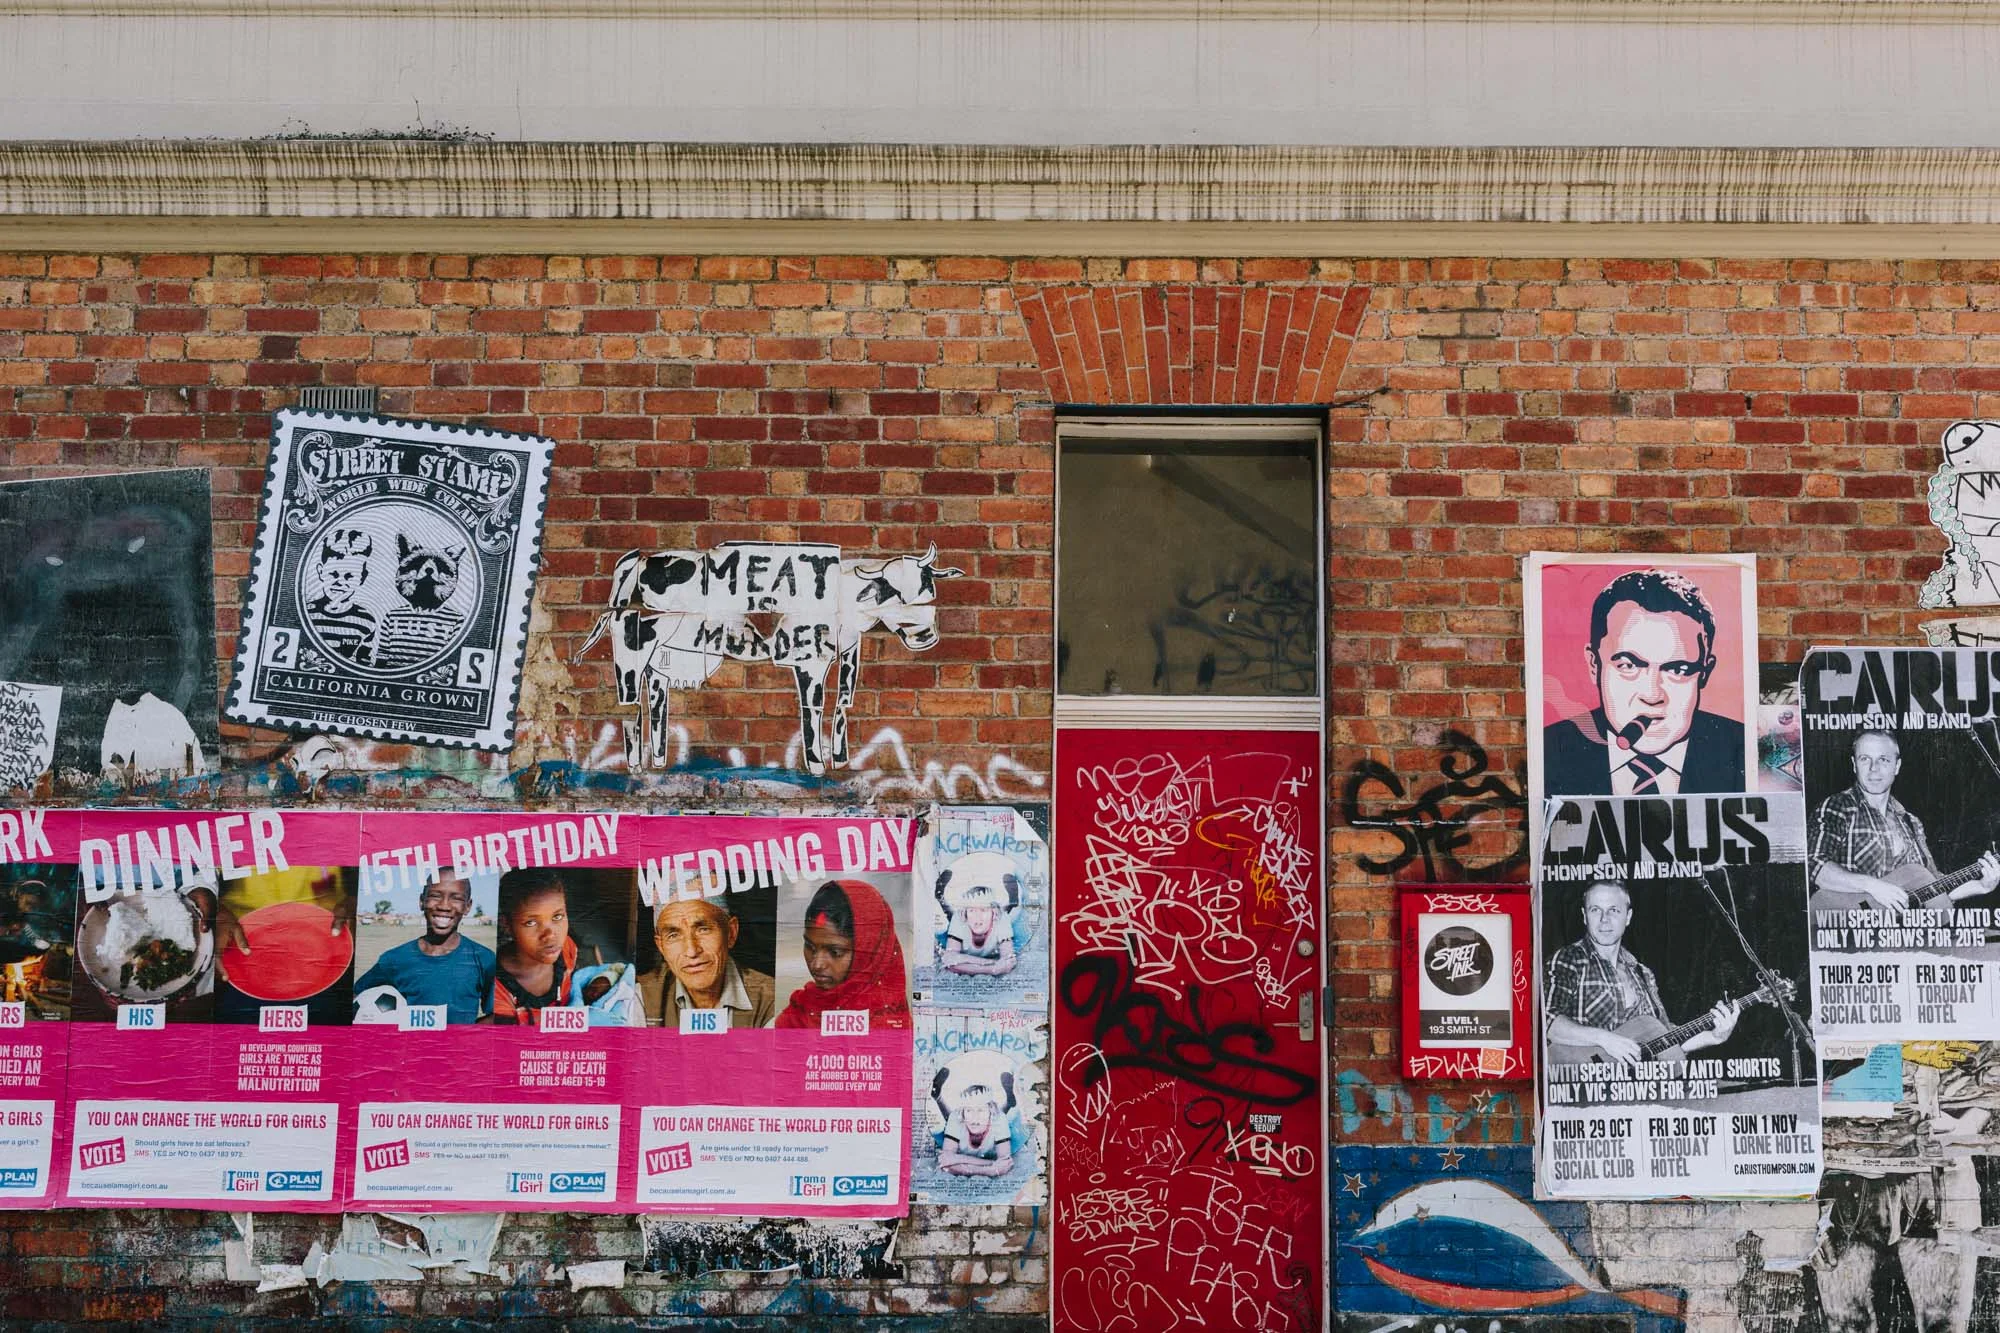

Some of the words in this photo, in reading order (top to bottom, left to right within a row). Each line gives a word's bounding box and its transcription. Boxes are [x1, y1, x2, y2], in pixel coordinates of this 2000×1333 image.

[309, 448, 405, 483] STREET
[418, 454, 515, 497] STAMP
[323, 479, 379, 514] WORLD
[388, 478, 430, 497] WIDE
[434, 488, 479, 528] COLAB
[701, 550, 839, 599] MEAT
[271, 631, 290, 663] 2
[269, 674, 391, 699] CALIFORNIA
[401, 688, 475, 709] GROWN
[1800, 651, 2000, 718] CARU
[312, 712, 336, 724] THE
[338, 714, 388, 729] CHOSEN
[391, 720, 417, 731] FEW
[1806, 712, 1898, 730] THOMPSON
[1903, 711, 1924, 730] AND
[1927, 712, 1972, 730] BAND
[1542, 797, 1770, 866] CARUS
[80, 811, 289, 904] DINNER
[359, 843, 441, 896] 15TH
[450, 814, 619, 881] BIRTHDAY
[637, 833, 827, 907] WEDDING
[837, 819, 913, 875] DAY
[1540, 863, 1628, 882] THOMPSON
[1633, 861, 1655, 880] AND
[1658, 861, 1702, 879] BAND
[1816, 909, 1847, 928] WITH
[1848, 908, 1899, 928] SPECIAL
[1903, 908, 1944, 928] GUEST
[1949, 908, 1991, 927] YANTO
[1816, 929, 1849, 949] ONLY
[1853, 929, 1875, 948] VIC
[1878, 929, 1924, 948] SHOWS
[1928, 928, 1952, 947] FOR
[1955, 928, 1986, 948] 2015
[1430, 942, 1480, 971] STREET
[1446, 961, 1481, 982] INK
[1819, 965, 1853, 984] THUR
[1857, 965, 1873, 984] 29
[1877, 964, 1900, 984] OCT
[1916, 964, 1936, 983] FRI
[1940, 964, 1956, 983] 30
[1960, 964, 1984, 983] OCT
[1820, 984, 1893, 1005] NORTHCOTE
[1917, 984, 1976, 1006] TORQUAY
[128, 1008, 154, 1026] HIS
[264, 1010, 304, 1028] HERS
[410, 1010, 436, 1027] HIS
[545, 1010, 585, 1029] HERS
[691, 1013, 717, 1031] HIS
[825, 1014, 865, 1032] HERS
[1441, 1016, 1472, 1025] LEVEL
[1473, 1016, 1479, 1025] 1
[1821, 1004, 1866, 1025] SOCIAL
[1870, 1004, 1902, 1024] CLUB
[1918, 1004, 1957, 1023] HOTEL
[1429, 1026, 1445, 1034] 193
[1446, 1026, 1477, 1034] SMITH
[1479, 1026, 1492, 1034] ST
[13, 1045, 43, 1058] GIRLS
[248, 1044, 286, 1053] DEVELOPING
[520, 1050, 560, 1060] CHILDBIRTH
[577, 1051, 606, 1060] LEADING
[25, 1059, 42, 1074] AN
[240, 1053, 263, 1064] GIRLS
[265, 1054, 281, 1064] ARE
[283, 1054, 309, 1064] TWICE
[520, 1061, 553, 1075] CAUSE
[556, 1061, 570, 1075] OF
[573, 1061, 606, 1075] DEATH
[806, 1054, 844, 1071] 41,000
[848, 1054, 882, 1070] GIRLS
[239, 1065, 266, 1076] LIKELY
[297, 1066, 321, 1077] FROM
[861, 1071, 882, 1081] THEIR
[1550, 1064, 1579, 1083] WITH
[1580, 1061, 1632, 1082] SPECIAL
[1635, 1060, 1676, 1081] GUEST
[1679, 1059, 1723, 1080] YANTO
[1726, 1057, 1781, 1079] SHORTIS
[238, 1077, 320, 1092] MALNUTRITION
[520, 1076, 535, 1086] FOR
[537, 1076, 560, 1086] GIRLS
[561, 1076, 582, 1087] AGED
[585, 1076, 606, 1087] 15-19
[805, 1081, 844, 1091] CHILDHOOD
[1550, 1083, 1580, 1104] ONLY
[1585, 1082, 1607, 1102] VIC
[1610, 1081, 1657, 1101] SHOWS
[1660, 1080, 1684, 1100] FOR
[1688, 1079, 1718, 1099] 2015
[8, 1111, 43, 1126] GIRLS
[88, 1111, 110, 1126] YOU
[114, 1111, 138, 1126] CAN
[142, 1112, 190, 1127] CHANGE
[194, 1113, 216, 1128] THE
[220, 1113, 261, 1128] WORLD
[266, 1114, 288, 1128] FOR
[292, 1114, 327, 1129] GIRLS
[371, 1113, 394, 1128] YOU
[397, 1114, 421, 1128] CAN
[425, 1114, 472, 1129] CHANGE
[477, 1114, 499, 1129] THE
[503, 1115, 545, 1130] WORLD
[548, 1115, 571, 1130] FOR
[575, 1116, 609, 1130] GIRLS
[653, 1116, 675, 1131] YOU
[680, 1117, 703, 1131] CAN
[707, 1117, 755, 1132] CHANGE
[759, 1118, 781, 1132] THE
[785, 1118, 826, 1133] WORLD
[831, 1119, 852, 1133] FOR
[857, 1119, 890, 1133] GIRLS
[1648, 1118, 1668, 1137] FRI
[1673, 1117, 1689, 1136] 30
[1693, 1116, 1717, 1136] OCT
[1732, 1115, 1758, 1135] SUN
[1761, 1115, 1768, 1134] 1
[1772, 1114, 1798, 1134] NOV
[1552, 1120, 1585, 1140] THUR
[1589, 1119, 1606, 1139] 29
[1610, 1118, 1633, 1138] OCT
[135, 1139, 159, 1147] Should
[160, 1140, 176, 1148] girls
[714, 1145, 729, 1153] girls
[1553, 1139, 1625, 1160] NORTHCOTE
[1650, 1137, 1709, 1160] TORQUAY
[1733, 1135, 1772, 1155] LORNE
[1776, 1134, 1815, 1154] HOTEL
[82, 1143, 122, 1167] VOTE
[366, 1145, 406, 1169] VOTE
[648, 1149, 688, 1173] VOTE
[5, 1172, 35, 1181] PLAN
[1555, 1159, 1599, 1180] SOCIAL
[1603, 1158, 1635, 1178] CLUB
[1651, 1157, 1690, 1178] HOTEL
[1734, 1162, 1815, 1176] CARUSTHOMPSON.COM
[289, 1175, 320, 1184] PLAN
[573, 1176, 603, 1185] PLAN
[856, 1179, 886, 1189] PLAN
